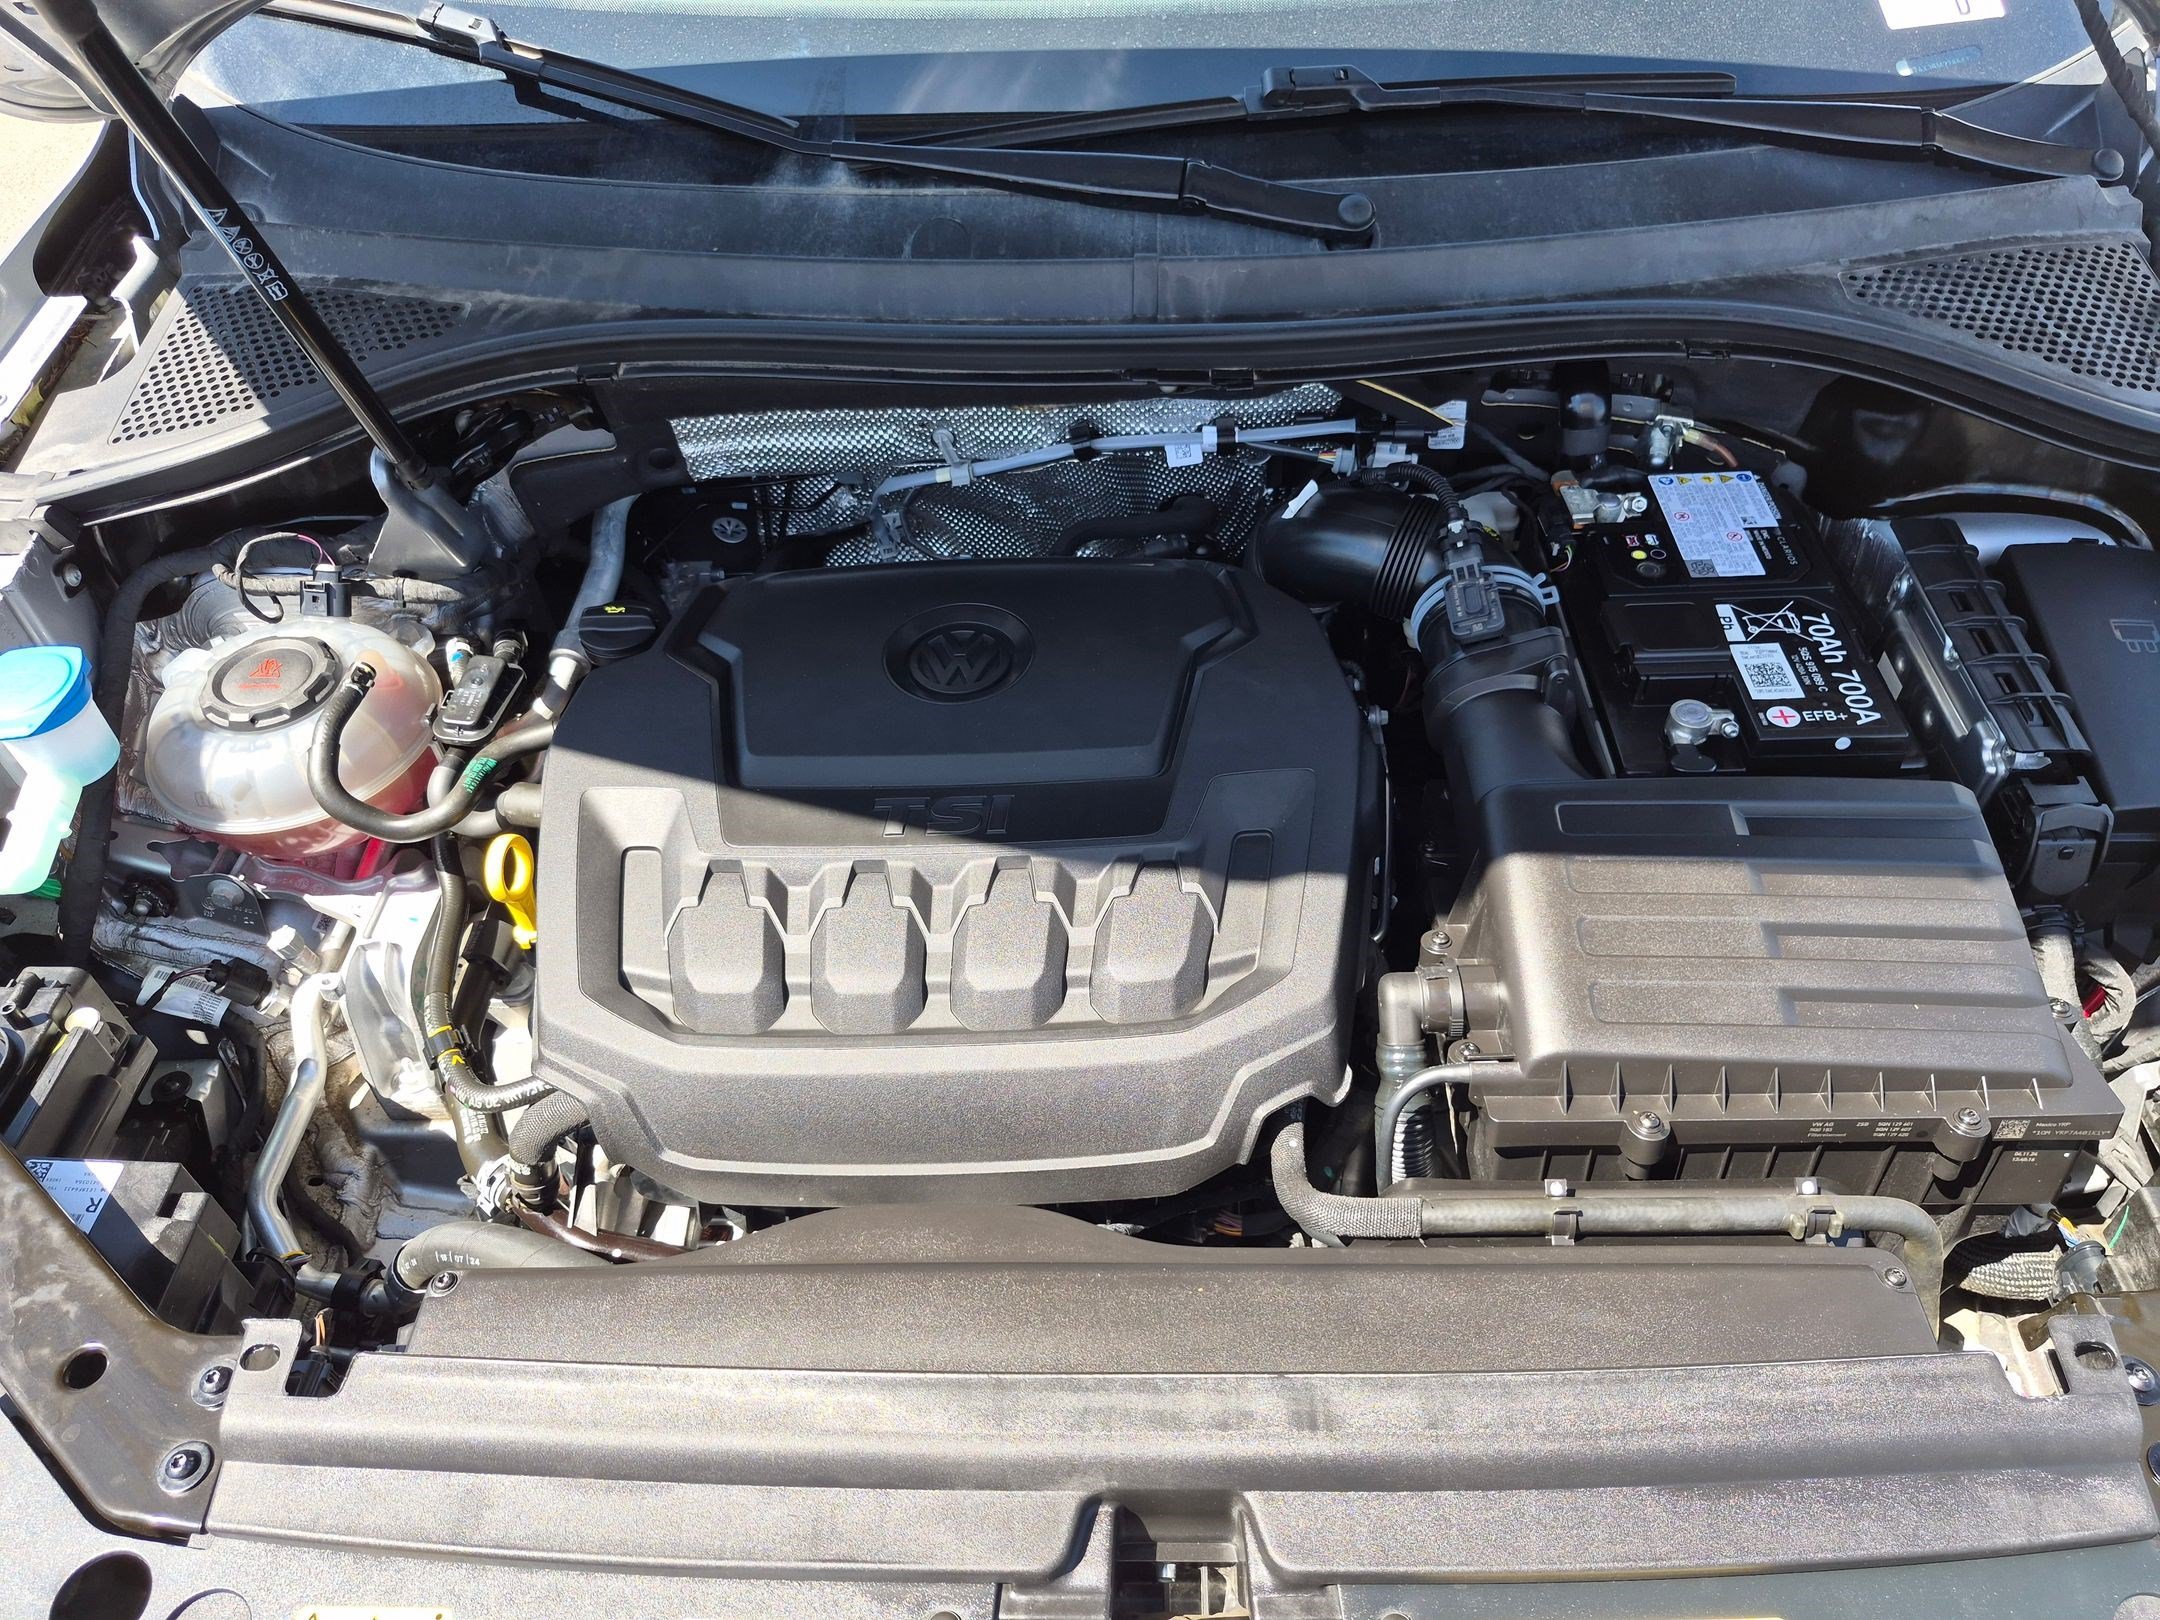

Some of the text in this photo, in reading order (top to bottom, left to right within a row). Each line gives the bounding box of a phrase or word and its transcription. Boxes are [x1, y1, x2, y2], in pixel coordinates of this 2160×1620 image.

[1777, 536, 1798, 566] CLARIOS
[1801, 613, 1882, 725] 70Ah 700A
[1802, 710, 1848, 722] EFB+
[874, 794, 1015, 837] TSI
[85, 1197, 103, 1213] R
